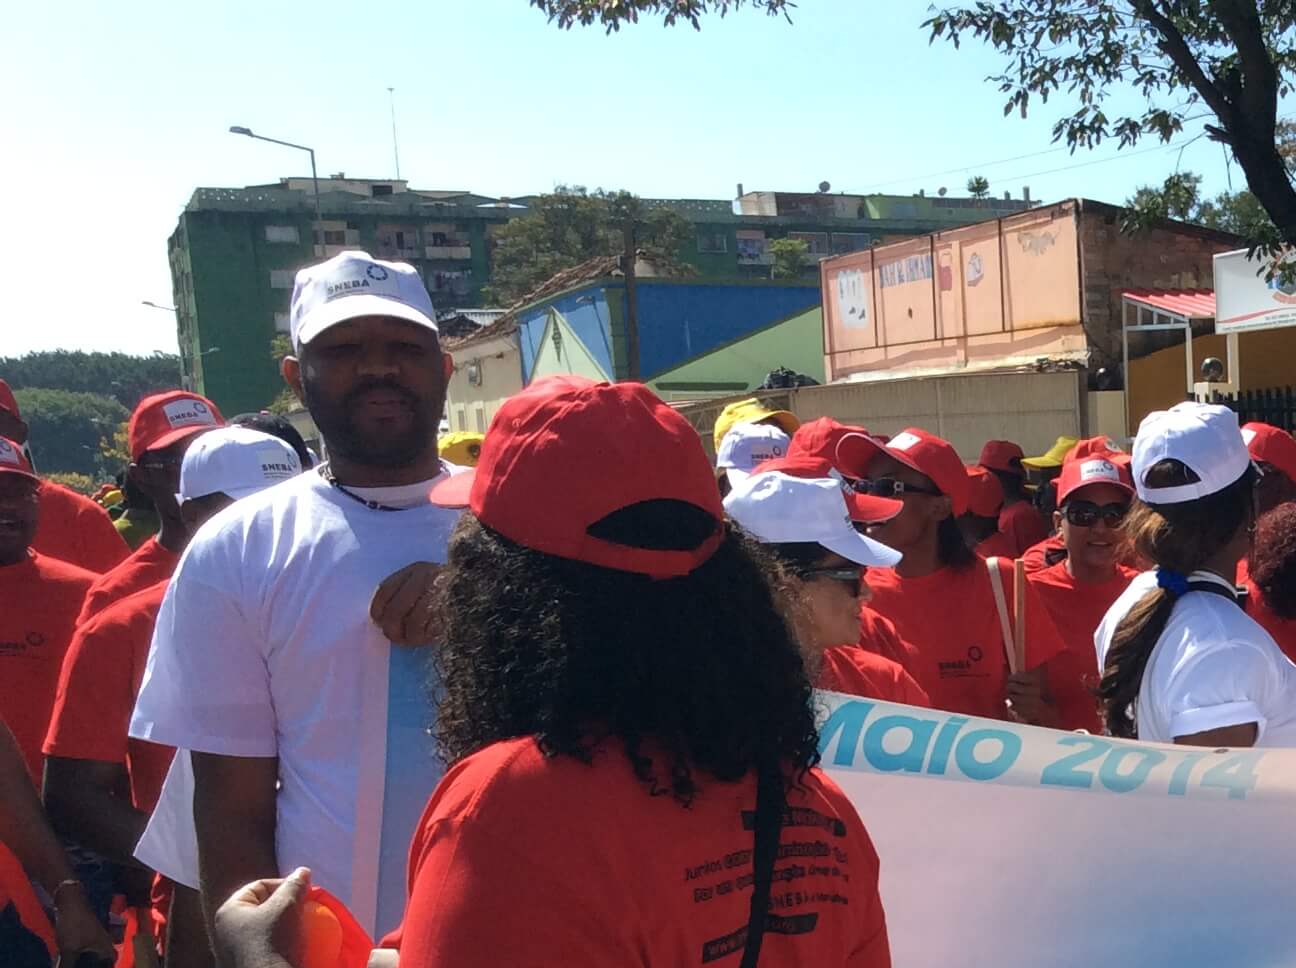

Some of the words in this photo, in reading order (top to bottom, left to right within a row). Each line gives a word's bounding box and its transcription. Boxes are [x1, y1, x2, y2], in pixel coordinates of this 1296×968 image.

[327, 279, 370, 293] SNEBA
[818, 700, 1022, 781] Maio
[1040, 736, 1259, 799] 2014
